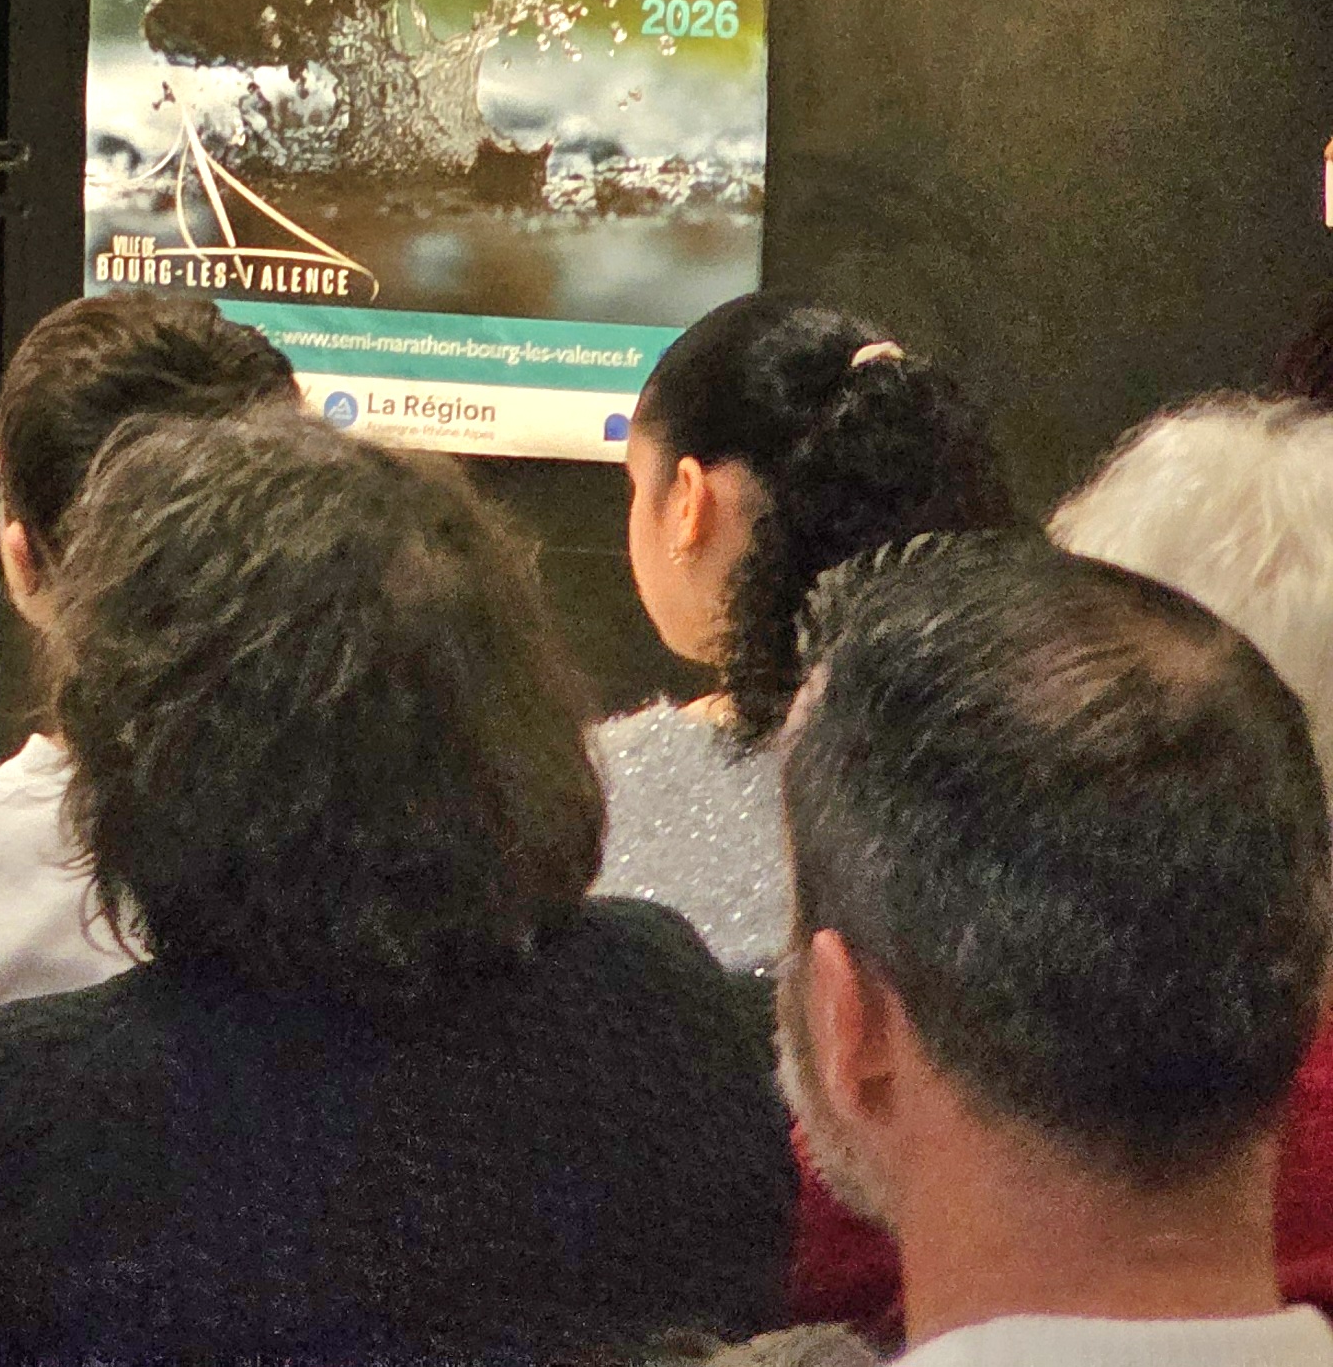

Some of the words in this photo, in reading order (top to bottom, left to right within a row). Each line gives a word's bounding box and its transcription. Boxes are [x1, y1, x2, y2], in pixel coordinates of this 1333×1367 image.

[113, 235, 141, 257] VILLE
[141, 237, 156, 257] DE
[366, 392, 395, 415] La
[404, 394, 496, 425] Région
